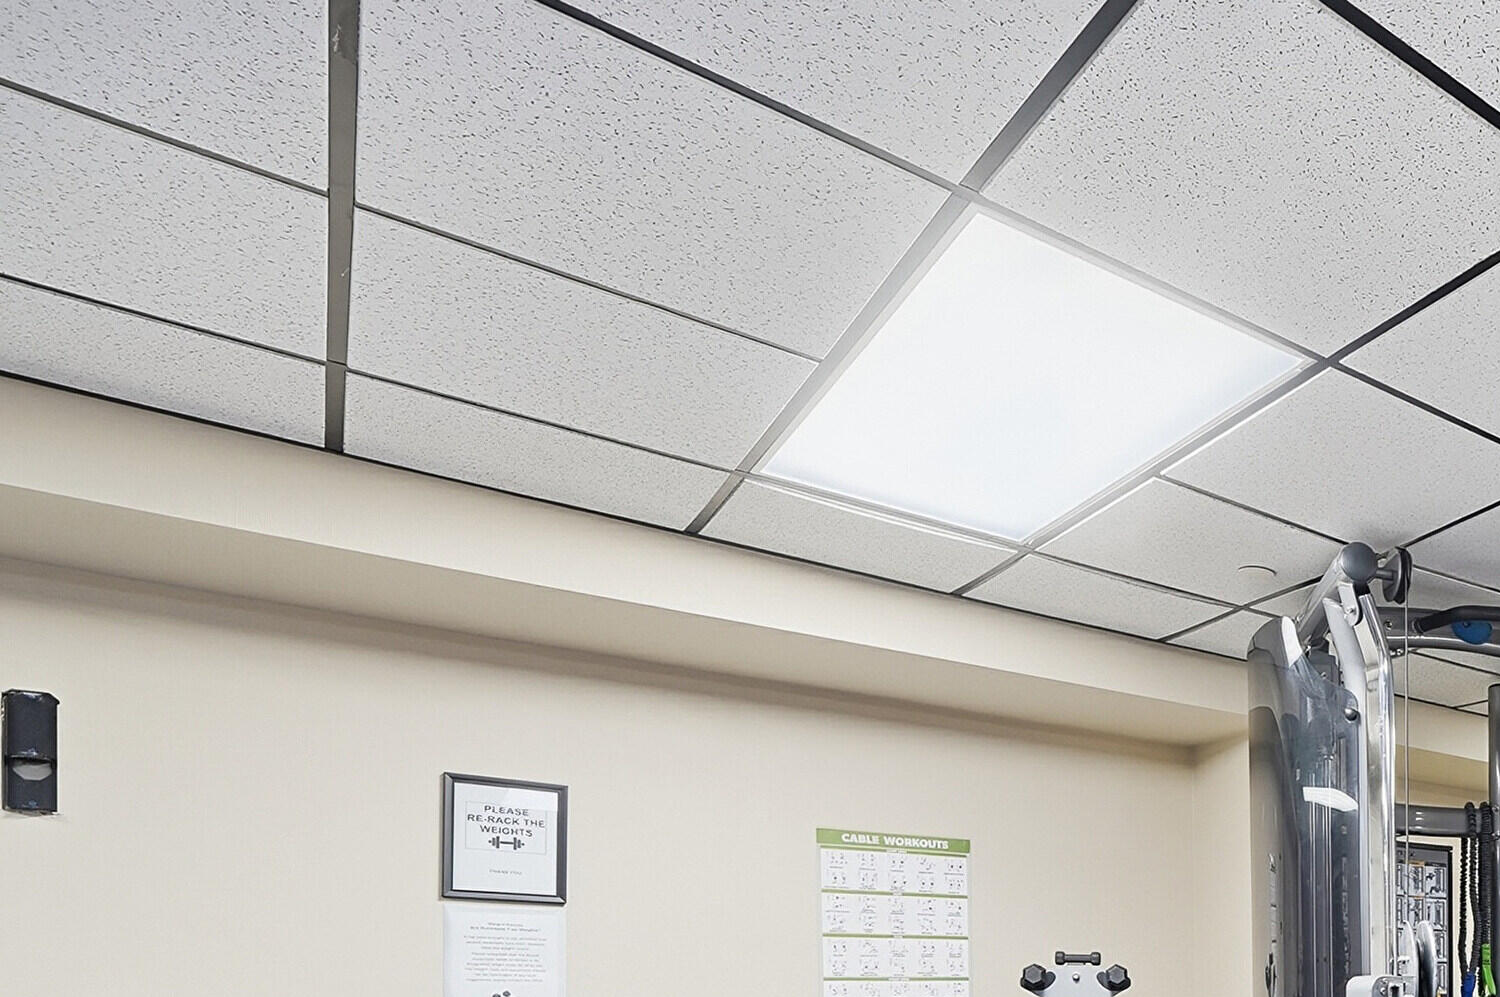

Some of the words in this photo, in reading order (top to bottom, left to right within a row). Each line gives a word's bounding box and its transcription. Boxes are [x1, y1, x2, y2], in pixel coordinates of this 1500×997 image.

[484, 805, 529, 817] PLEASE
[467, 814, 520, 825] RE-RACK
[524, 819, 545, 828] THE
[480, 825, 533, 837] WEIGHTS
[841, 833, 880, 845] CABLE
[883, 836, 949, 849] WORKOUTS
